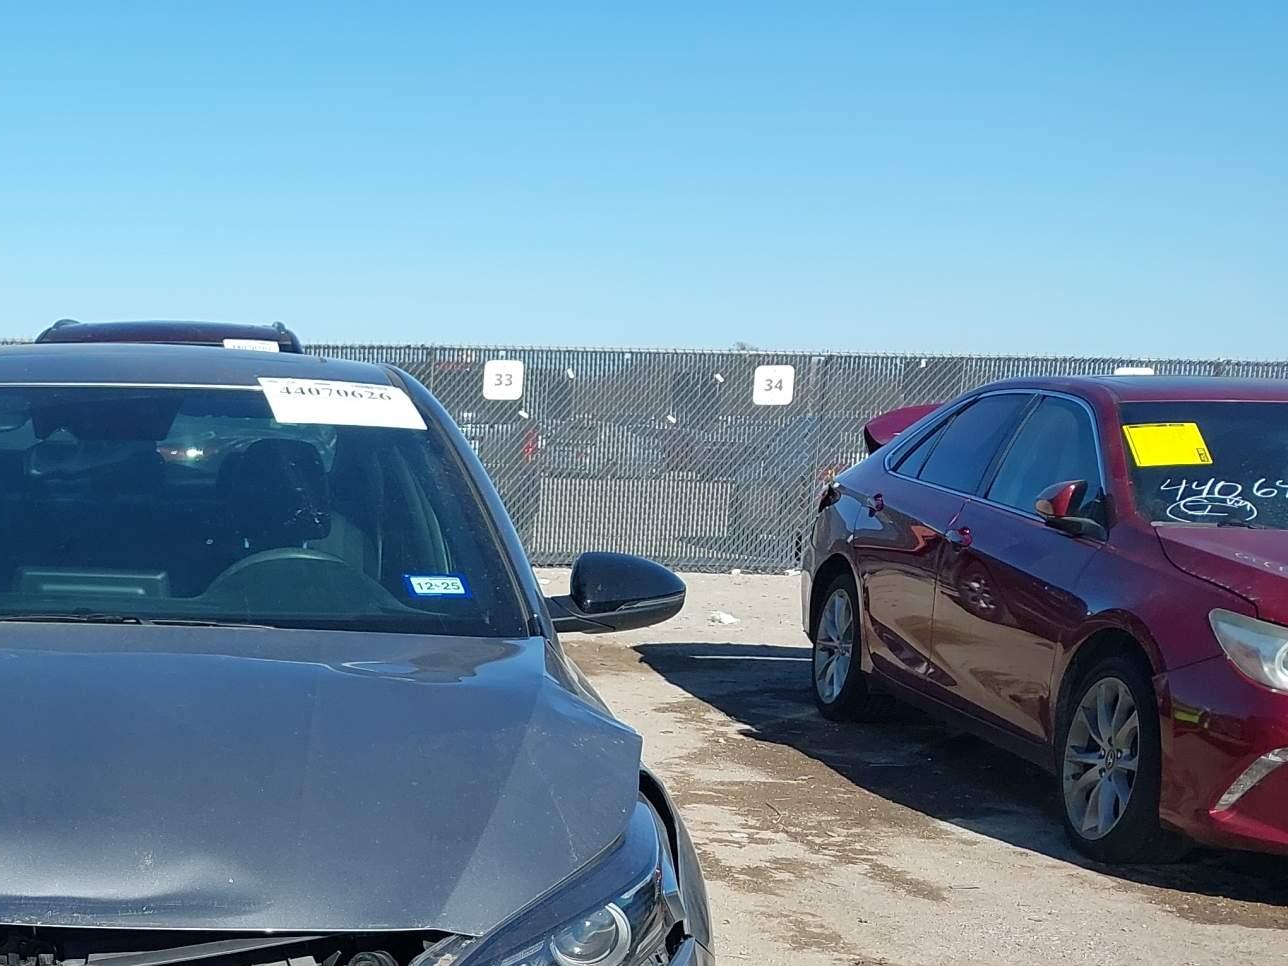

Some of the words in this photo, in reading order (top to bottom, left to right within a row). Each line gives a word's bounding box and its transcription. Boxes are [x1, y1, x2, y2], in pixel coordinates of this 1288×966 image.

[494, 373, 513, 387] 33
[763, 378, 784, 392] 34
[279, 385, 393, 401] 44070626
